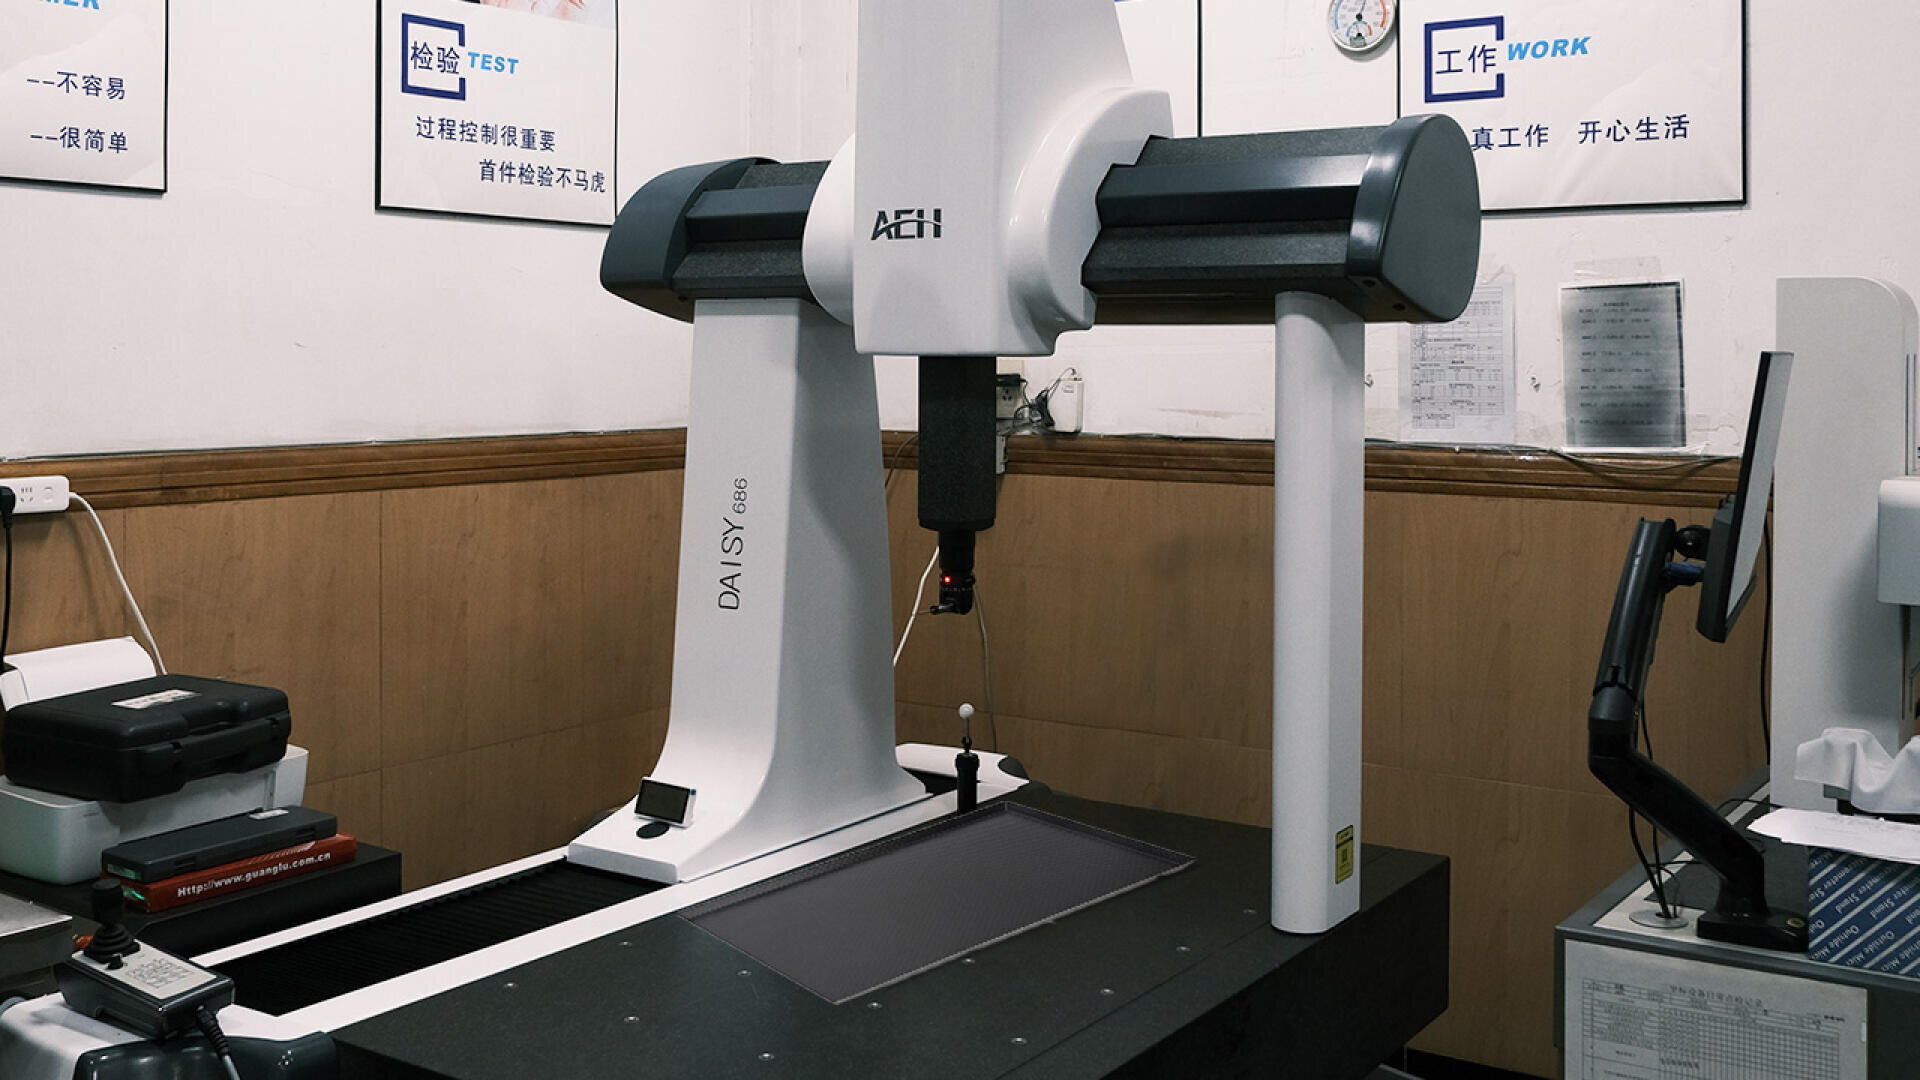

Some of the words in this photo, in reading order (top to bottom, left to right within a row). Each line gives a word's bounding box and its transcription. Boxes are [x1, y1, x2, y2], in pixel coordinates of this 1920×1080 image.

[410, 40, 460, 74] 检验
[467, 51, 519, 74] TEST
[1435, 44, 1497, 74] 工作
[1507, 36, 1592, 61] WORK
[416, 115, 556, 152] 过程控制很重要
[1577, 113, 1690, 145] 开心生活
[479, 158, 606, 193] 首件检验不马虎
[871, 207, 942, 241] AEH
[718, 516, 744, 610] DAISY
[732, 477, 748, 514] 686
